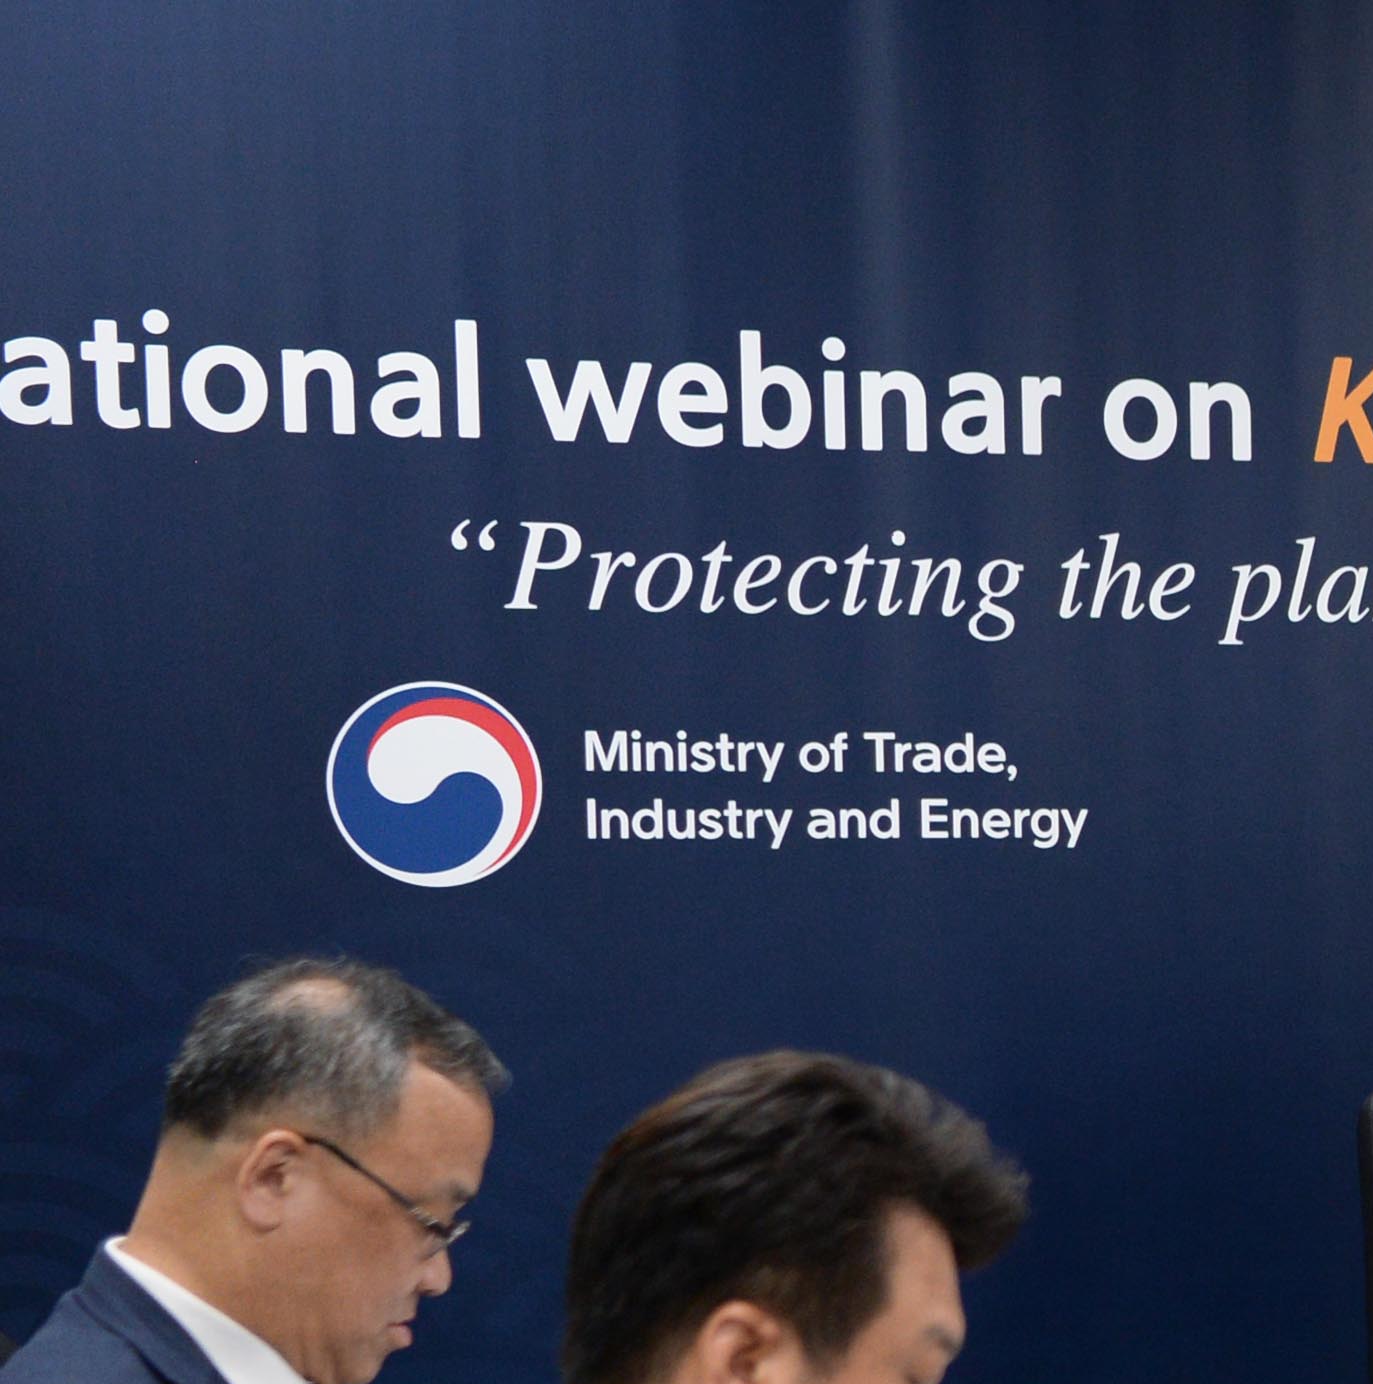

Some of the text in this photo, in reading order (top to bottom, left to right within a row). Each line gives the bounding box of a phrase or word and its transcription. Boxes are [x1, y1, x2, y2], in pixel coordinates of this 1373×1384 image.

[0, 309, 480, 438] ational
[526, 330, 1061, 455] webinar
[1104, 379, 1251, 461] on
[1060, 533, 1195, 620] the
[585, 730, 1017, 782] Ministry of Trade,
[587, 798, 1088, 849] Industry and Energy
